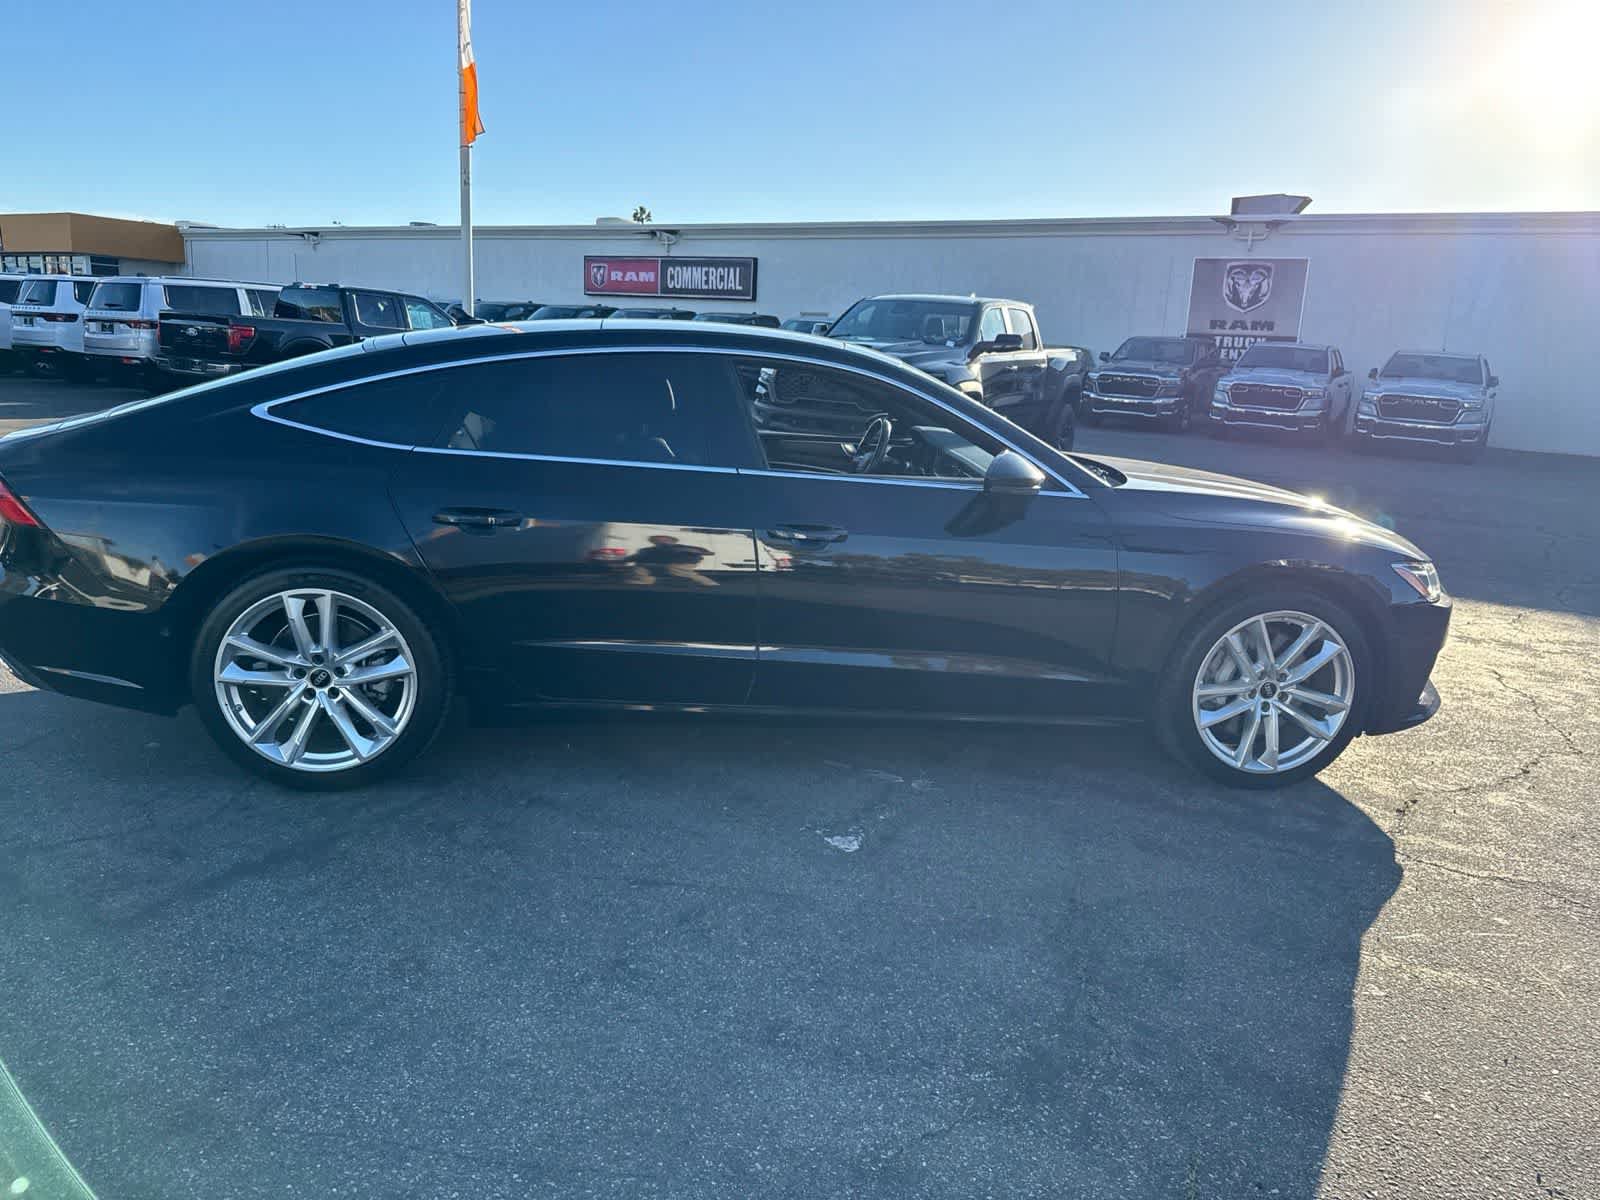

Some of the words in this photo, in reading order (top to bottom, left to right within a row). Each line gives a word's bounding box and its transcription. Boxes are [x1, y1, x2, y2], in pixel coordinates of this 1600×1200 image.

[610, 271, 655, 282] RAM
[667, 266, 743, 291] COMMERCIAL
[1208, 319, 1275, 331] RAM
